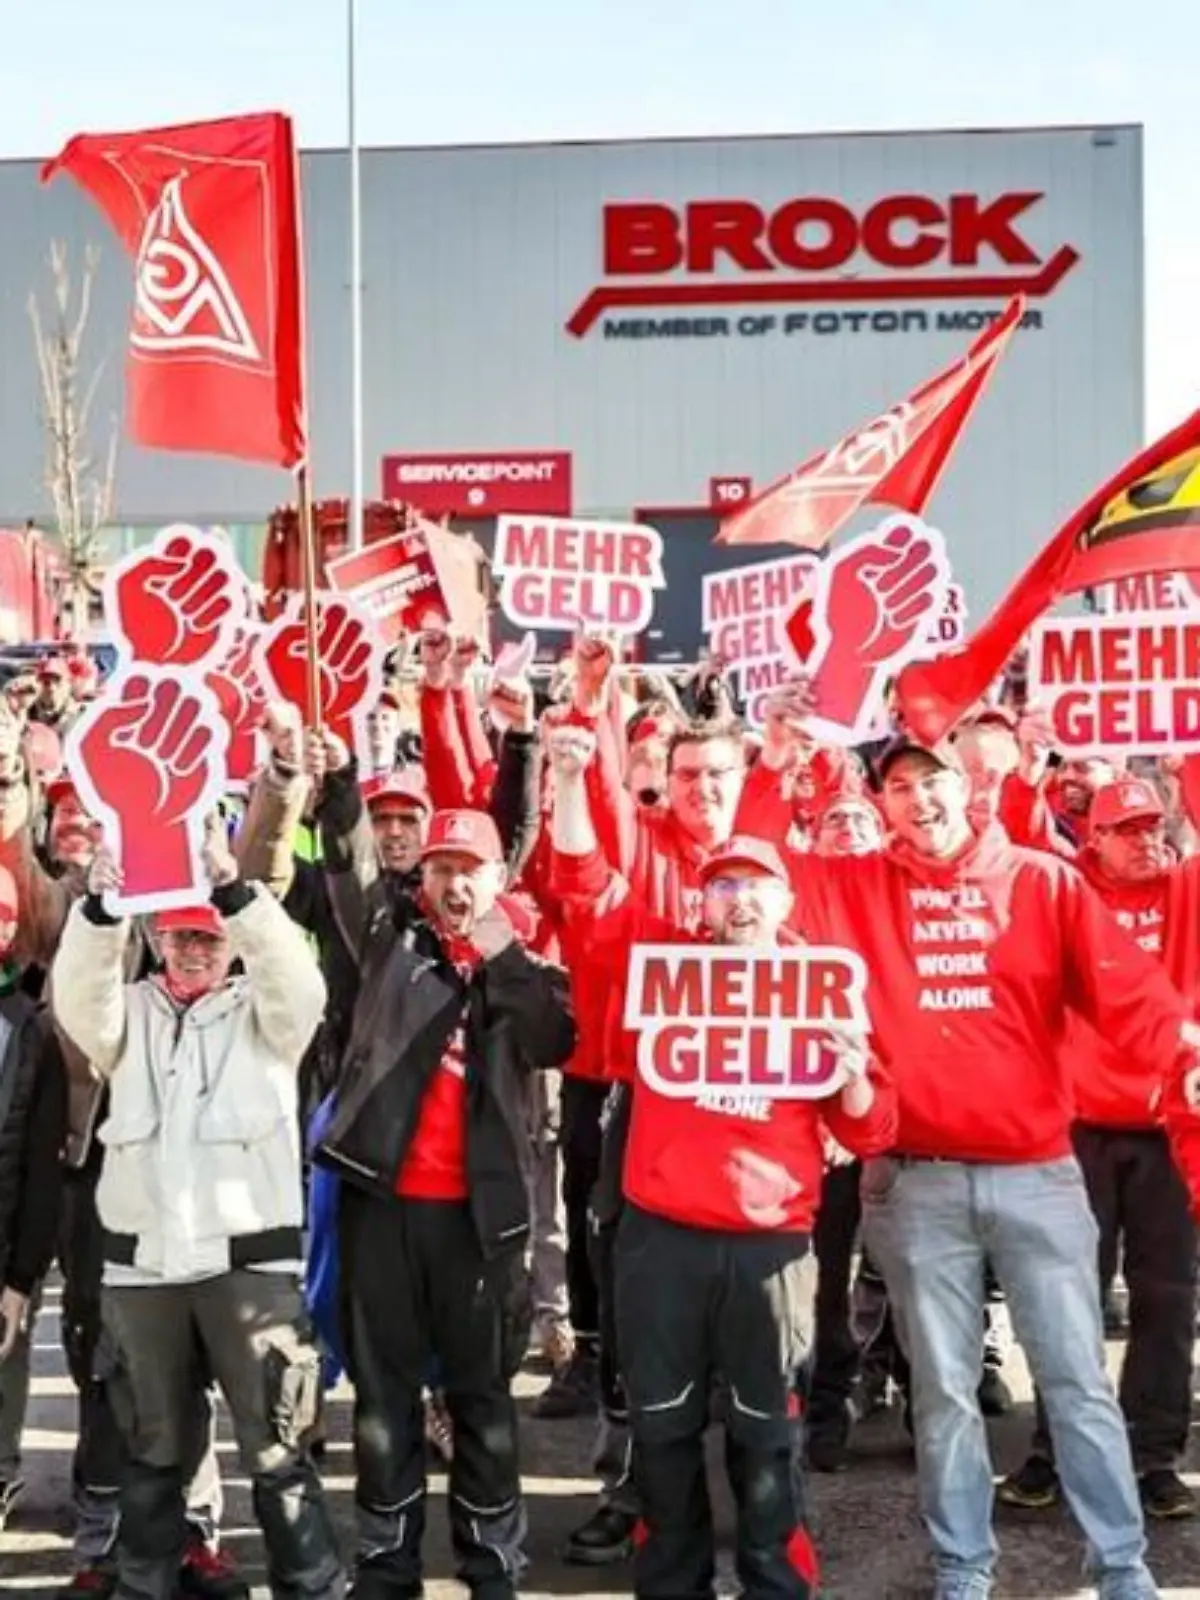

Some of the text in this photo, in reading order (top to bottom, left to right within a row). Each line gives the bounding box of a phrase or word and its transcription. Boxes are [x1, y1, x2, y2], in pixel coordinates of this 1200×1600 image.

[603, 192, 1044, 275] BROCK
[604, 309, 1043, 339] MEMBER OF FOTON MOTR
[398, 460, 557, 483] SERVICEPOINT
[716, 482, 745, 501] 10
[504, 523, 653, 576] MEHR
[512, 574, 643, 624] GELD
[718, 616, 782, 661] GEL
[639, 956, 855, 1018] MEHR
[916, 952, 988, 977] WORK
[919, 986, 993, 1010] ALONE
[651, 1025, 836, 1085] GELD
